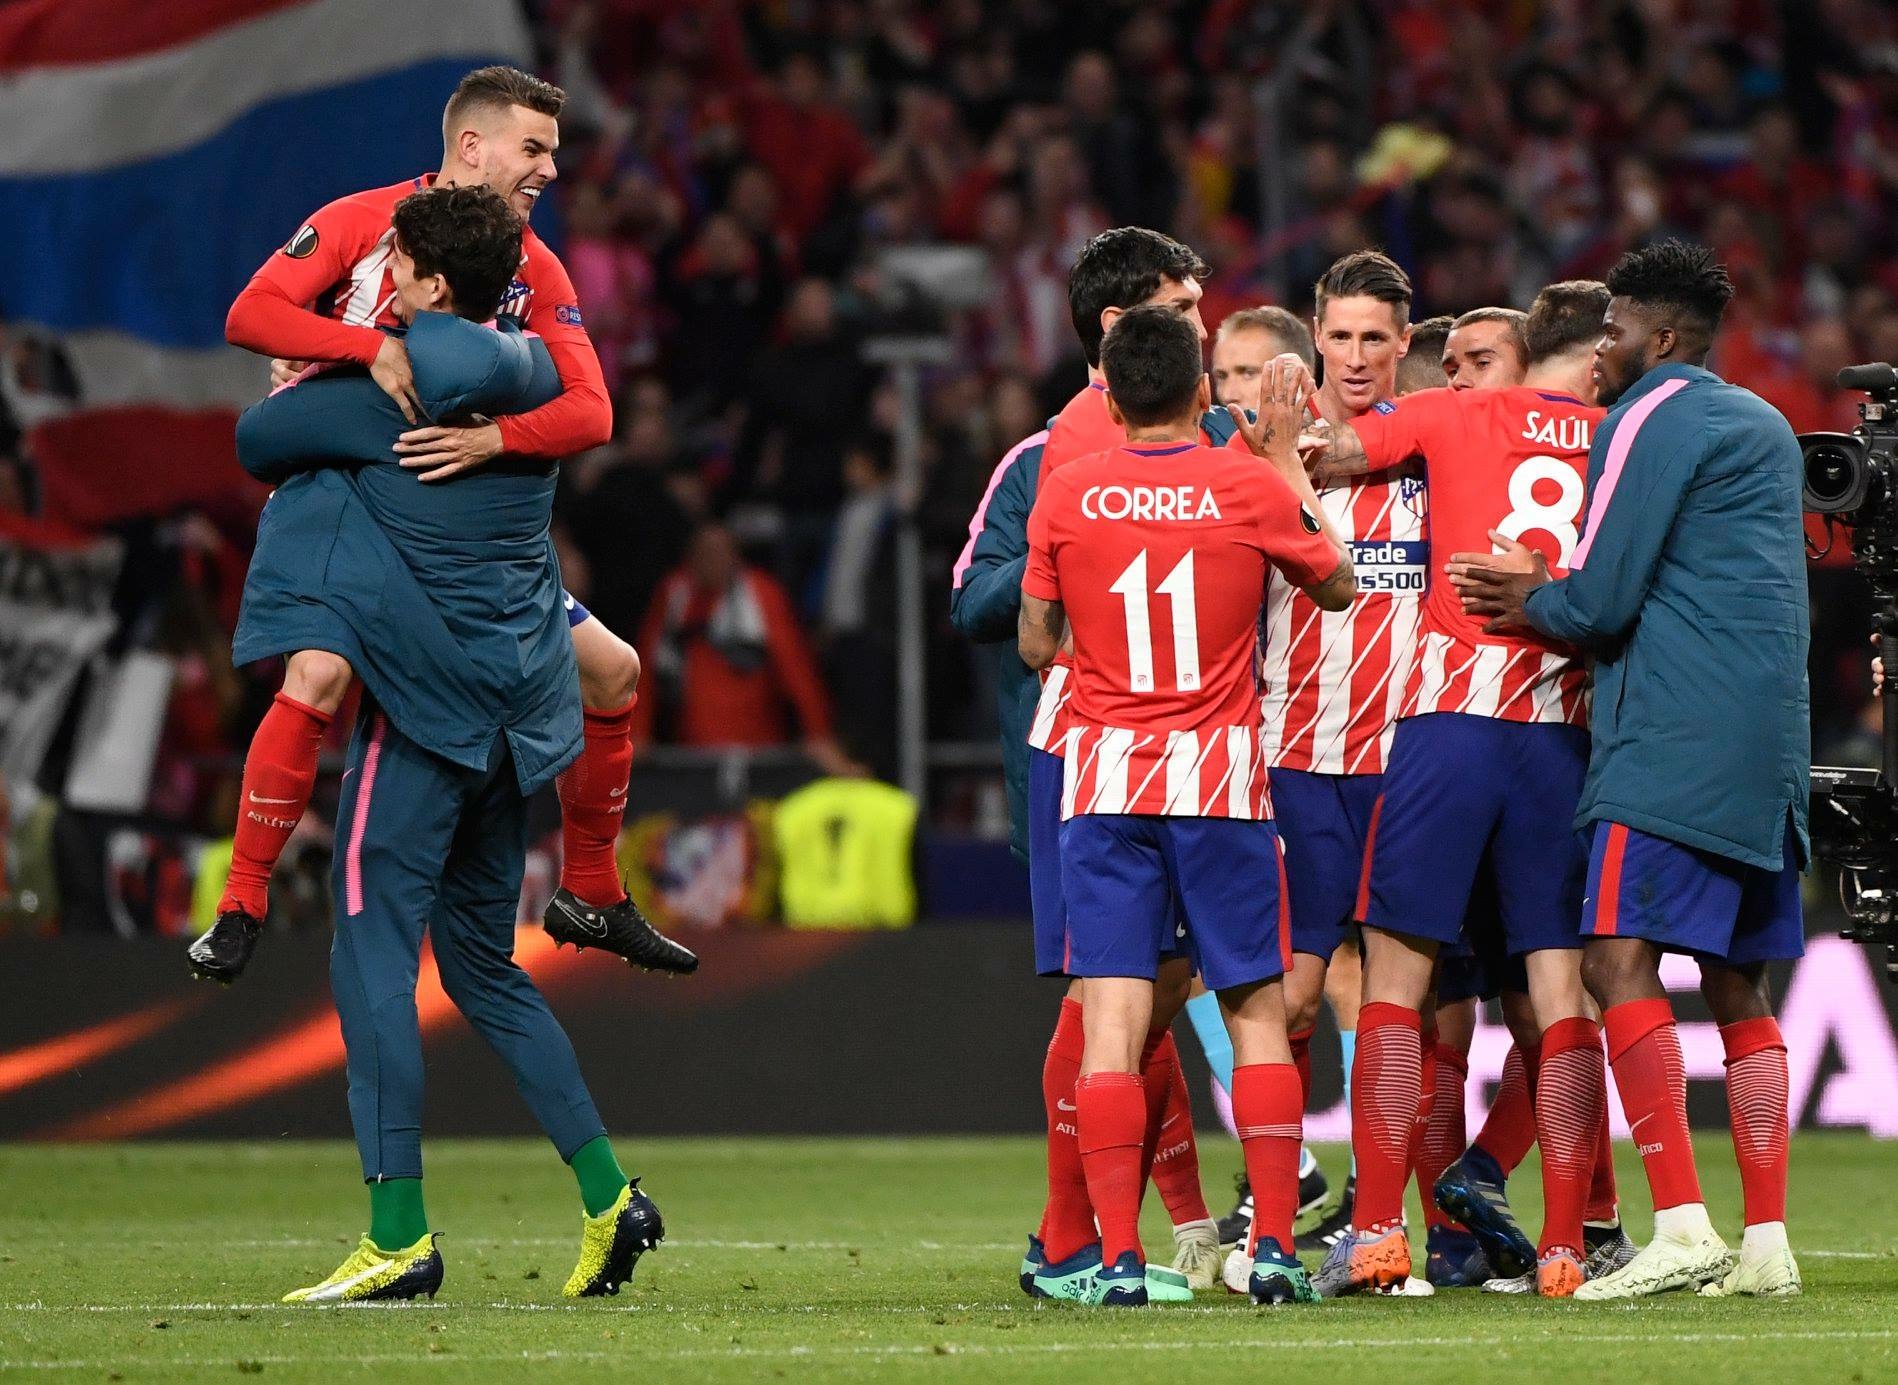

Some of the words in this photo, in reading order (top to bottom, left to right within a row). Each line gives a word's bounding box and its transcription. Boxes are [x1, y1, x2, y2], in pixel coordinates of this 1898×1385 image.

[1521, 410, 1592, 450] SAÚL
[1081, 485, 1223, 521] CORREA
[1491, 454, 1585, 571] 8
[1107, 546, 1202, 693] 11
